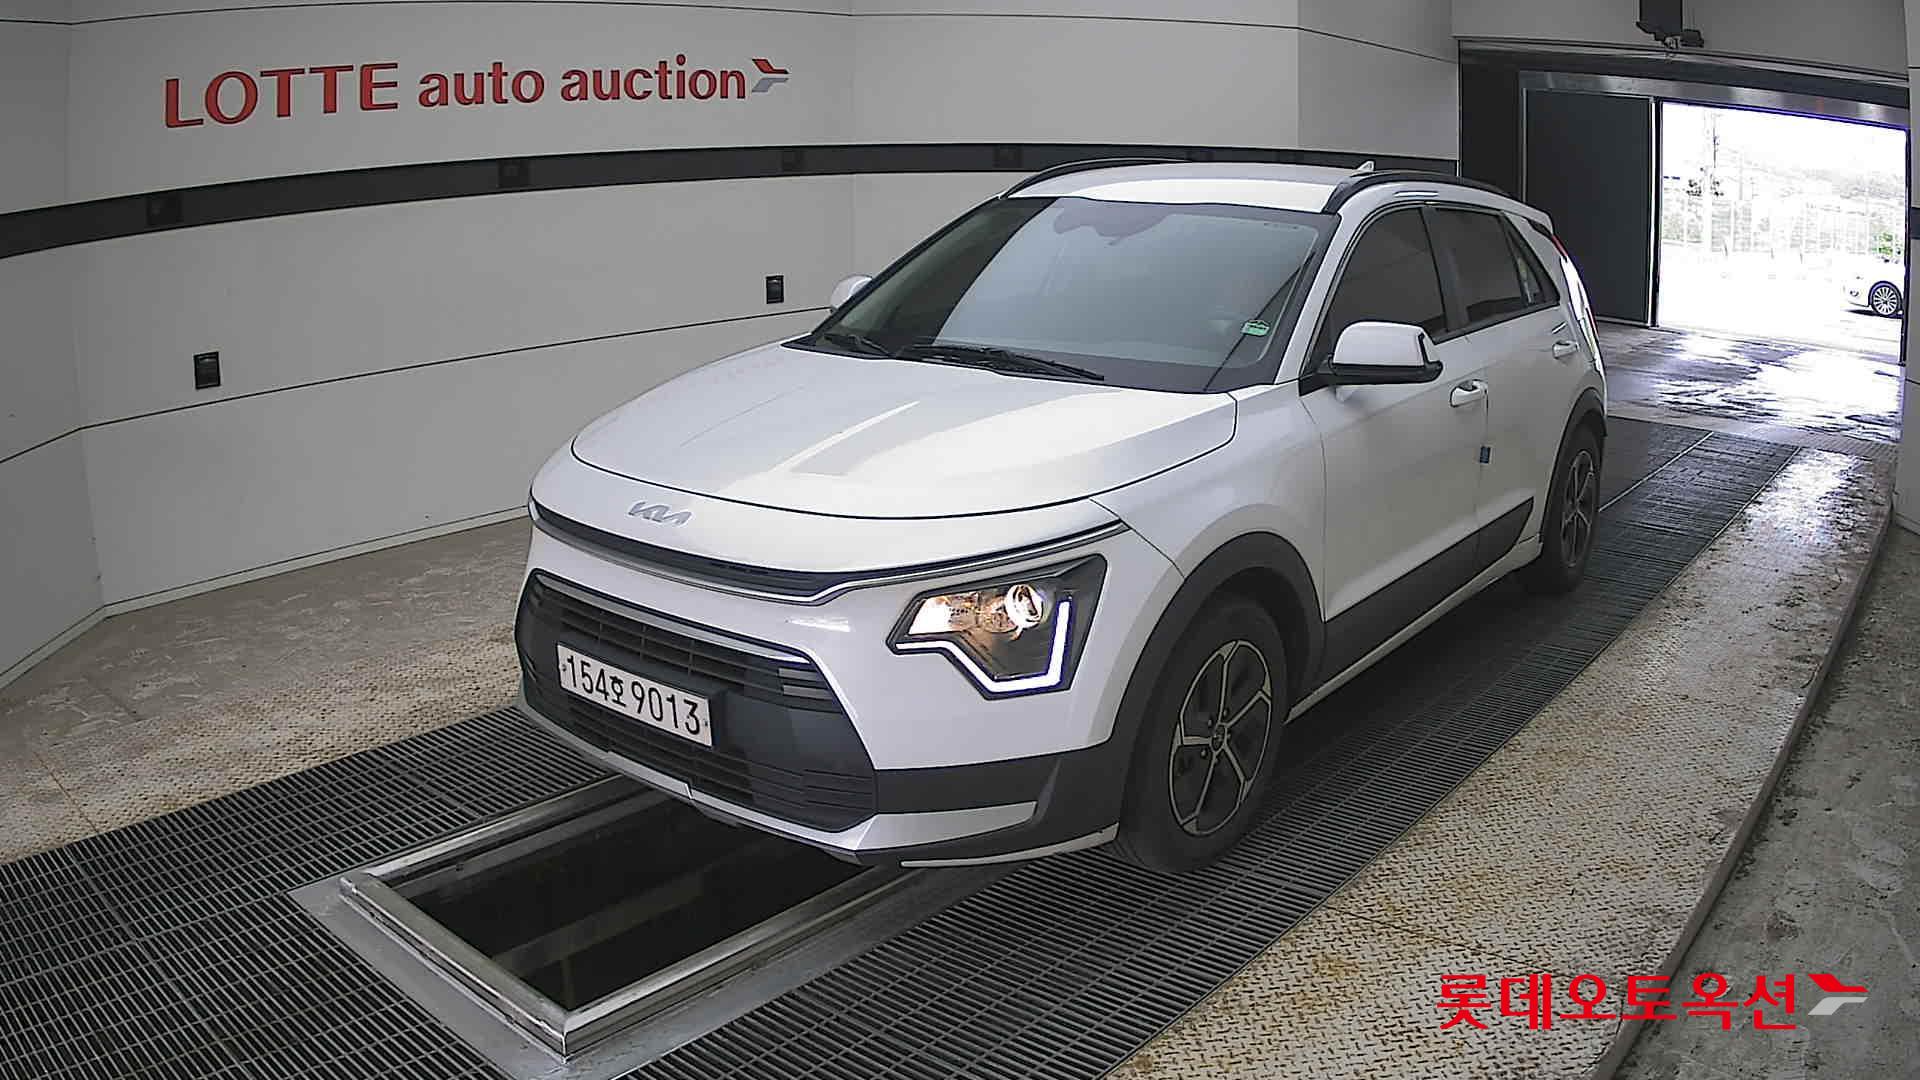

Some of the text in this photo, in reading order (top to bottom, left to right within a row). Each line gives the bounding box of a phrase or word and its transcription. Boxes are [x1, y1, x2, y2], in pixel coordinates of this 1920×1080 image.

[165, 53, 747, 128] LOTTE auto auction
[628, 501, 692, 525] KIA
[631, 680, 700, 735] 9013
